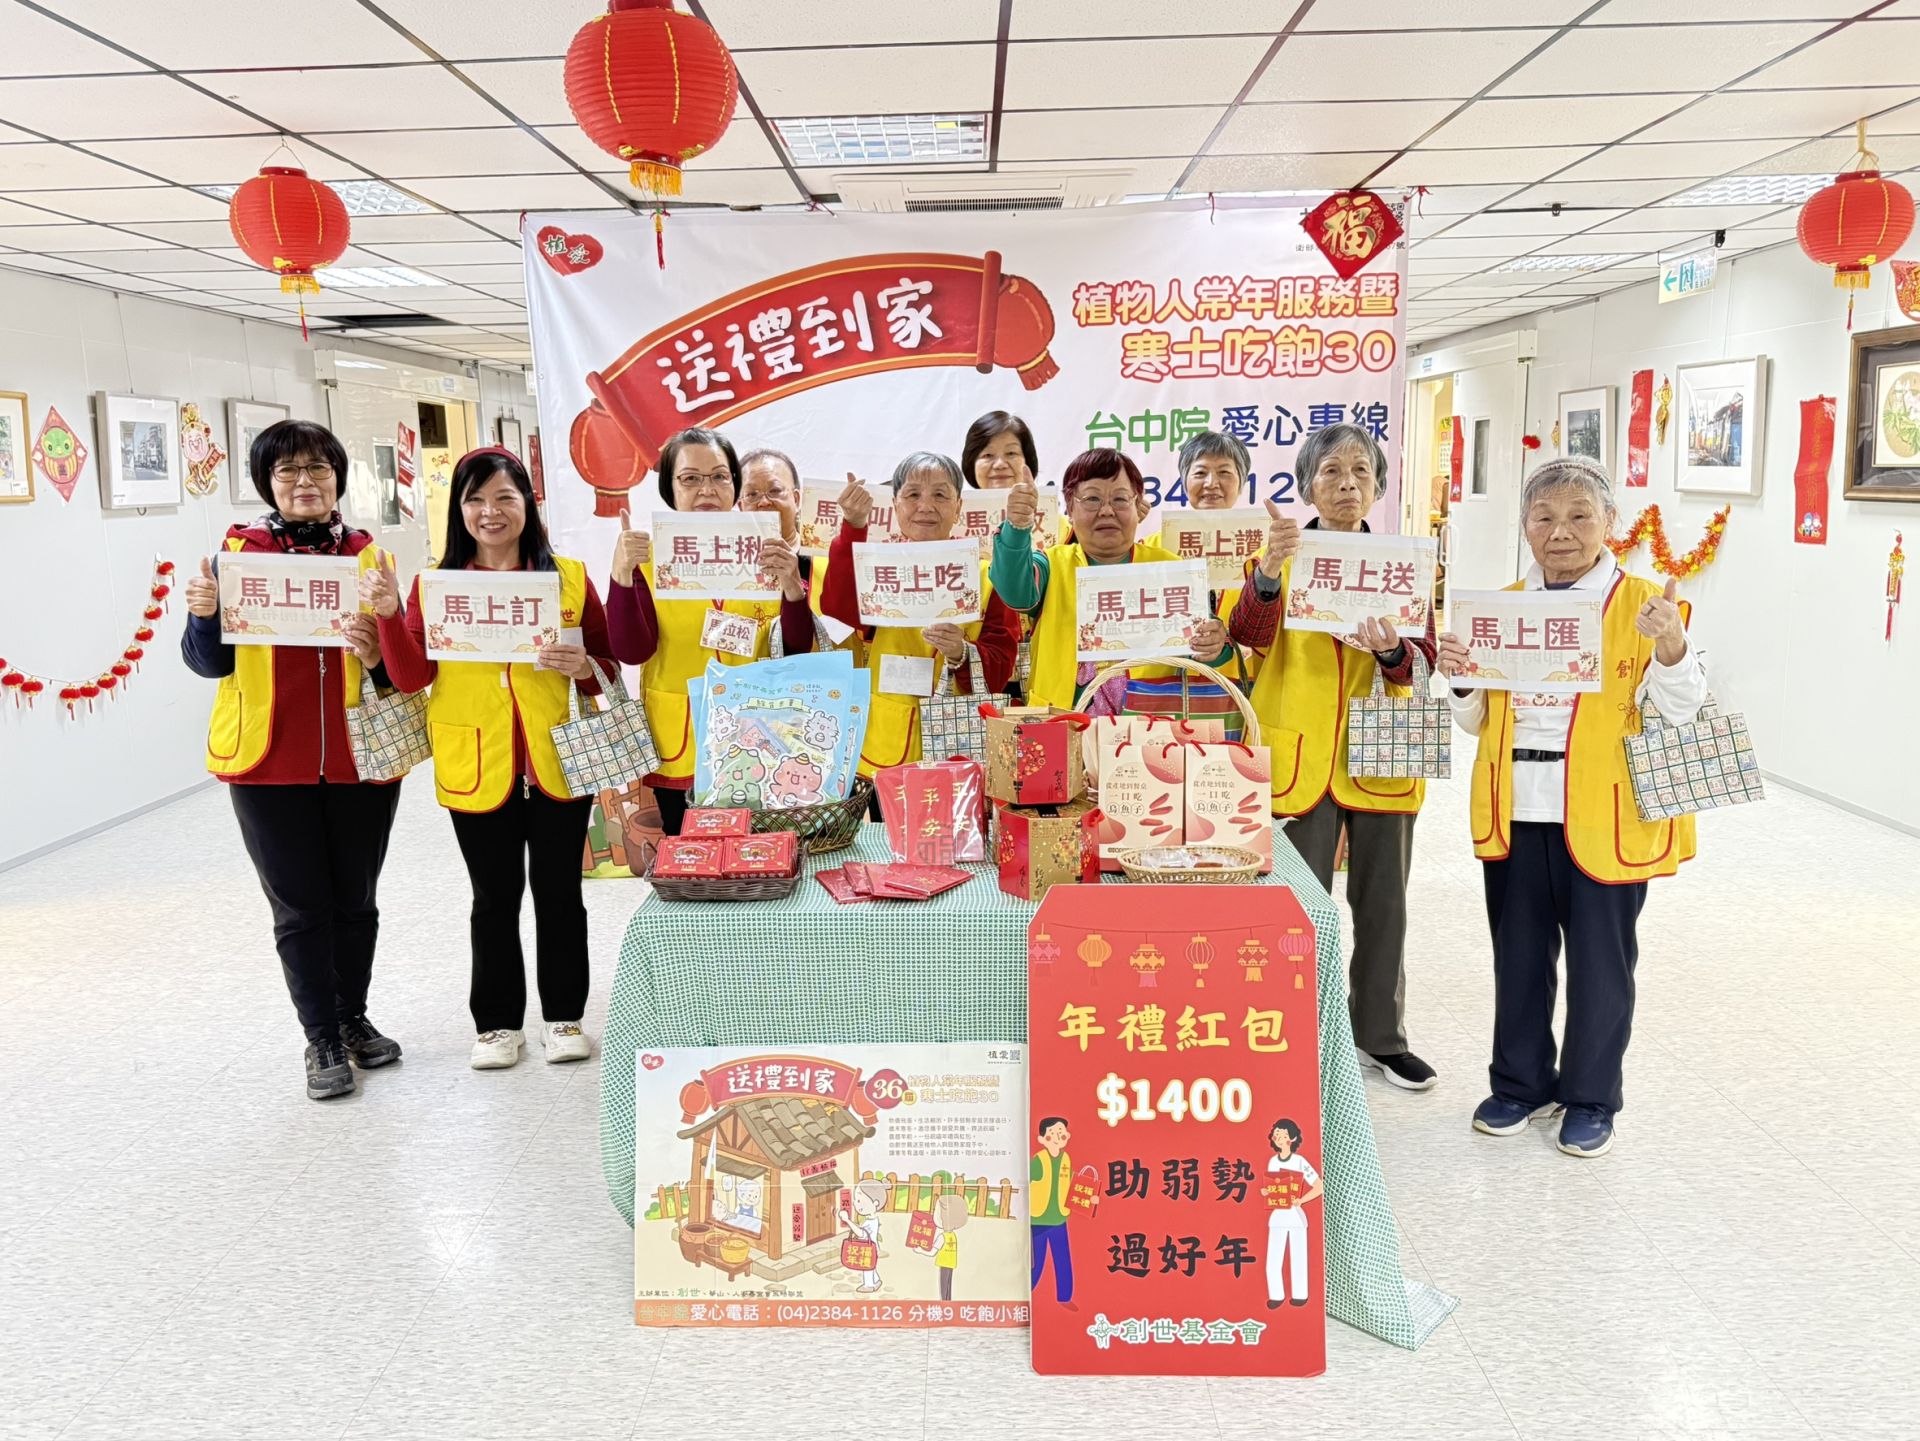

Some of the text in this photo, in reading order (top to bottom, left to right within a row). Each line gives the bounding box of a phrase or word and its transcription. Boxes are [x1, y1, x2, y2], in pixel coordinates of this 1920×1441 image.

[1322, 195, 1377, 259] 福
[1074, 274, 1399, 326] 植物人常年服務暨
[656, 277, 943, 413] 送禮到家
[1121, 325, 1397, 382] 寒士吃飽30
[1084, 401, 1389, 452] 台中院 愛心專線
[670, 535, 766, 565] 馬上揪
[1177, 529, 1264, 558] 馬上讚
[873, 562, 966, 594] 馬上吃
[1307, 557, 1416, 596] 馬上送
[238, 577, 341, 611] 馬上開
[442, 594, 544, 626] 馬上訂
[1094, 586, 1193, 623] 馬上買
[1468, 617, 1581, 650] 馬上匯
[1615, 657, 1635, 680] 創
[920, 787, 941, 837] 平安
[1057, 1003, 1289, 1053] 年禮紅包
[727, 1064, 836, 1094] 送禮到家
[872, 1078, 904, 1099] 36
[1096, 1072, 1253, 1128] $1400
[1105, 1157, 1256, 1203] 助弱勢
[910, 1223, 933, 1237] 祝福
[846, 1245, 873, 1257] 祝福
[1106, 1233, 1257, 1279] 過好年
[908, 1304, 954, 1322] 分機9
[960, 1305, 1029, 1322] 吃飽小組
[1122, 1317, 1267, 1346] 創世基金會
